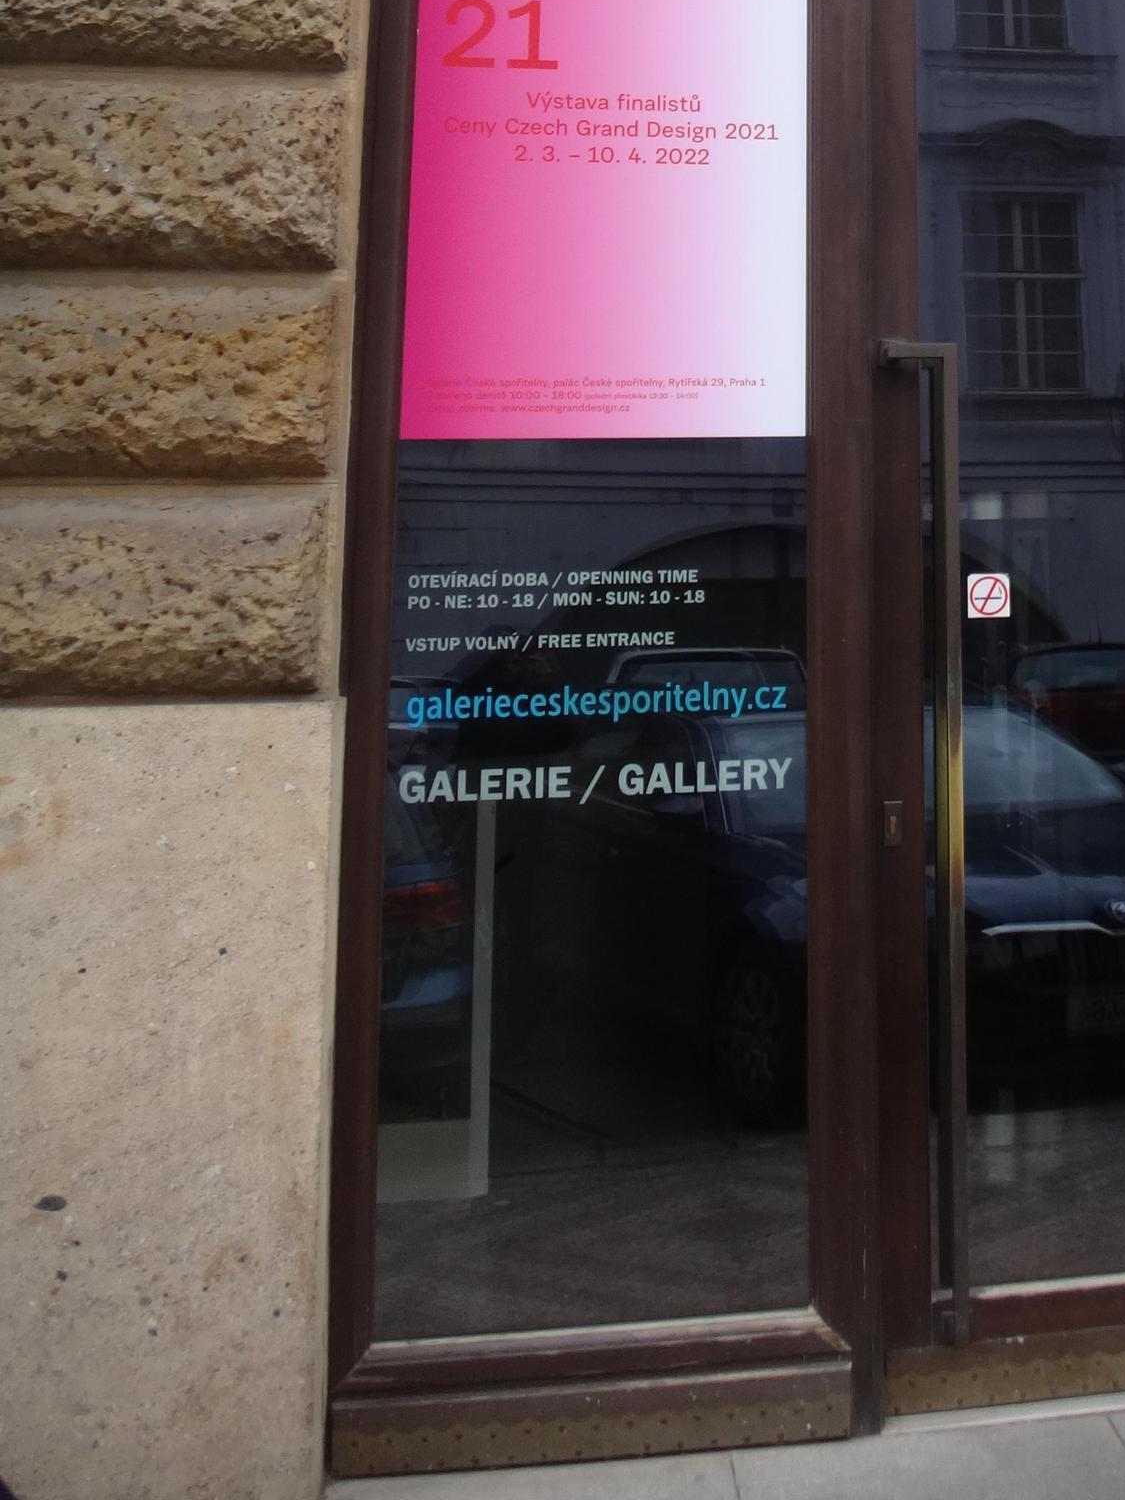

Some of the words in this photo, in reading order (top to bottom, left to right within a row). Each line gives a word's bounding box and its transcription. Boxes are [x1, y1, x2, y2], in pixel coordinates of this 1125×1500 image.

[526, 91, 609, 113] Výstava
[617, 93, 701, 112] finalistů
[443, 116, 497, 139] Ceny
[505, 118, 568, 136] Czech
[576, 119, 639, 137] Grand
[647, 121, 717, 143] Design
[725, 122, 779, 141] 2021
[514, 144, 533, 162] 2.
[542, 145, 560, 162] 3.
[587, 146, 620, 164] 10.
[628, 147, 647, 164] 4.
[655, 148, 710, 165] 2022
[553, 377, 579, 389] palác
[582, 375, 612, 387] České
[615, 377, 666, 389] spořitelny,
[668, 376, 708, 389] Rytířská
[711, 378, 726, 388] 29,
[729, 377, 757, 387] Praha
[760, 378, 766, 387] 1
[510, 390, 540, 400] 10:00
[551, 390, 582, 400] 18:00
[408, 569, 498, 589] OTEVÍRACÍ
[501, 572, 549, 587] DOBA
[552, 572, 563, 589] /
[567, 570, 653, 586] OPENNING
[657, 569, 699, 584] TIME
[407, 595, 431, 610] PO
[444, 595, 472, 609] NE:
[476, 594, 499, 608] 10
[512, 593, 535, 608] 18
[537, 593, 549, 610] /
[553, 592, 592, 607] MON
[605, 591, 645, 606] SUN:
[649, 590, 671, 605] 10
[683, 590, 705, 604] 18
[405, 637, 461, 652] VSTUP
[464, 632, 519, 651] VOLNÝ
[521, 635, 533, 653] /
[538, 634, 582, 649] FREE
[586, 631, 675, 647] ENTRANCE
[406, 681, 788, 728] galerieceskesporitelny.cz
[399, 766, 572, 804] GALERIE
[579, 765, 606, 804] /
[618, 757, 792, 797] GALLERY
